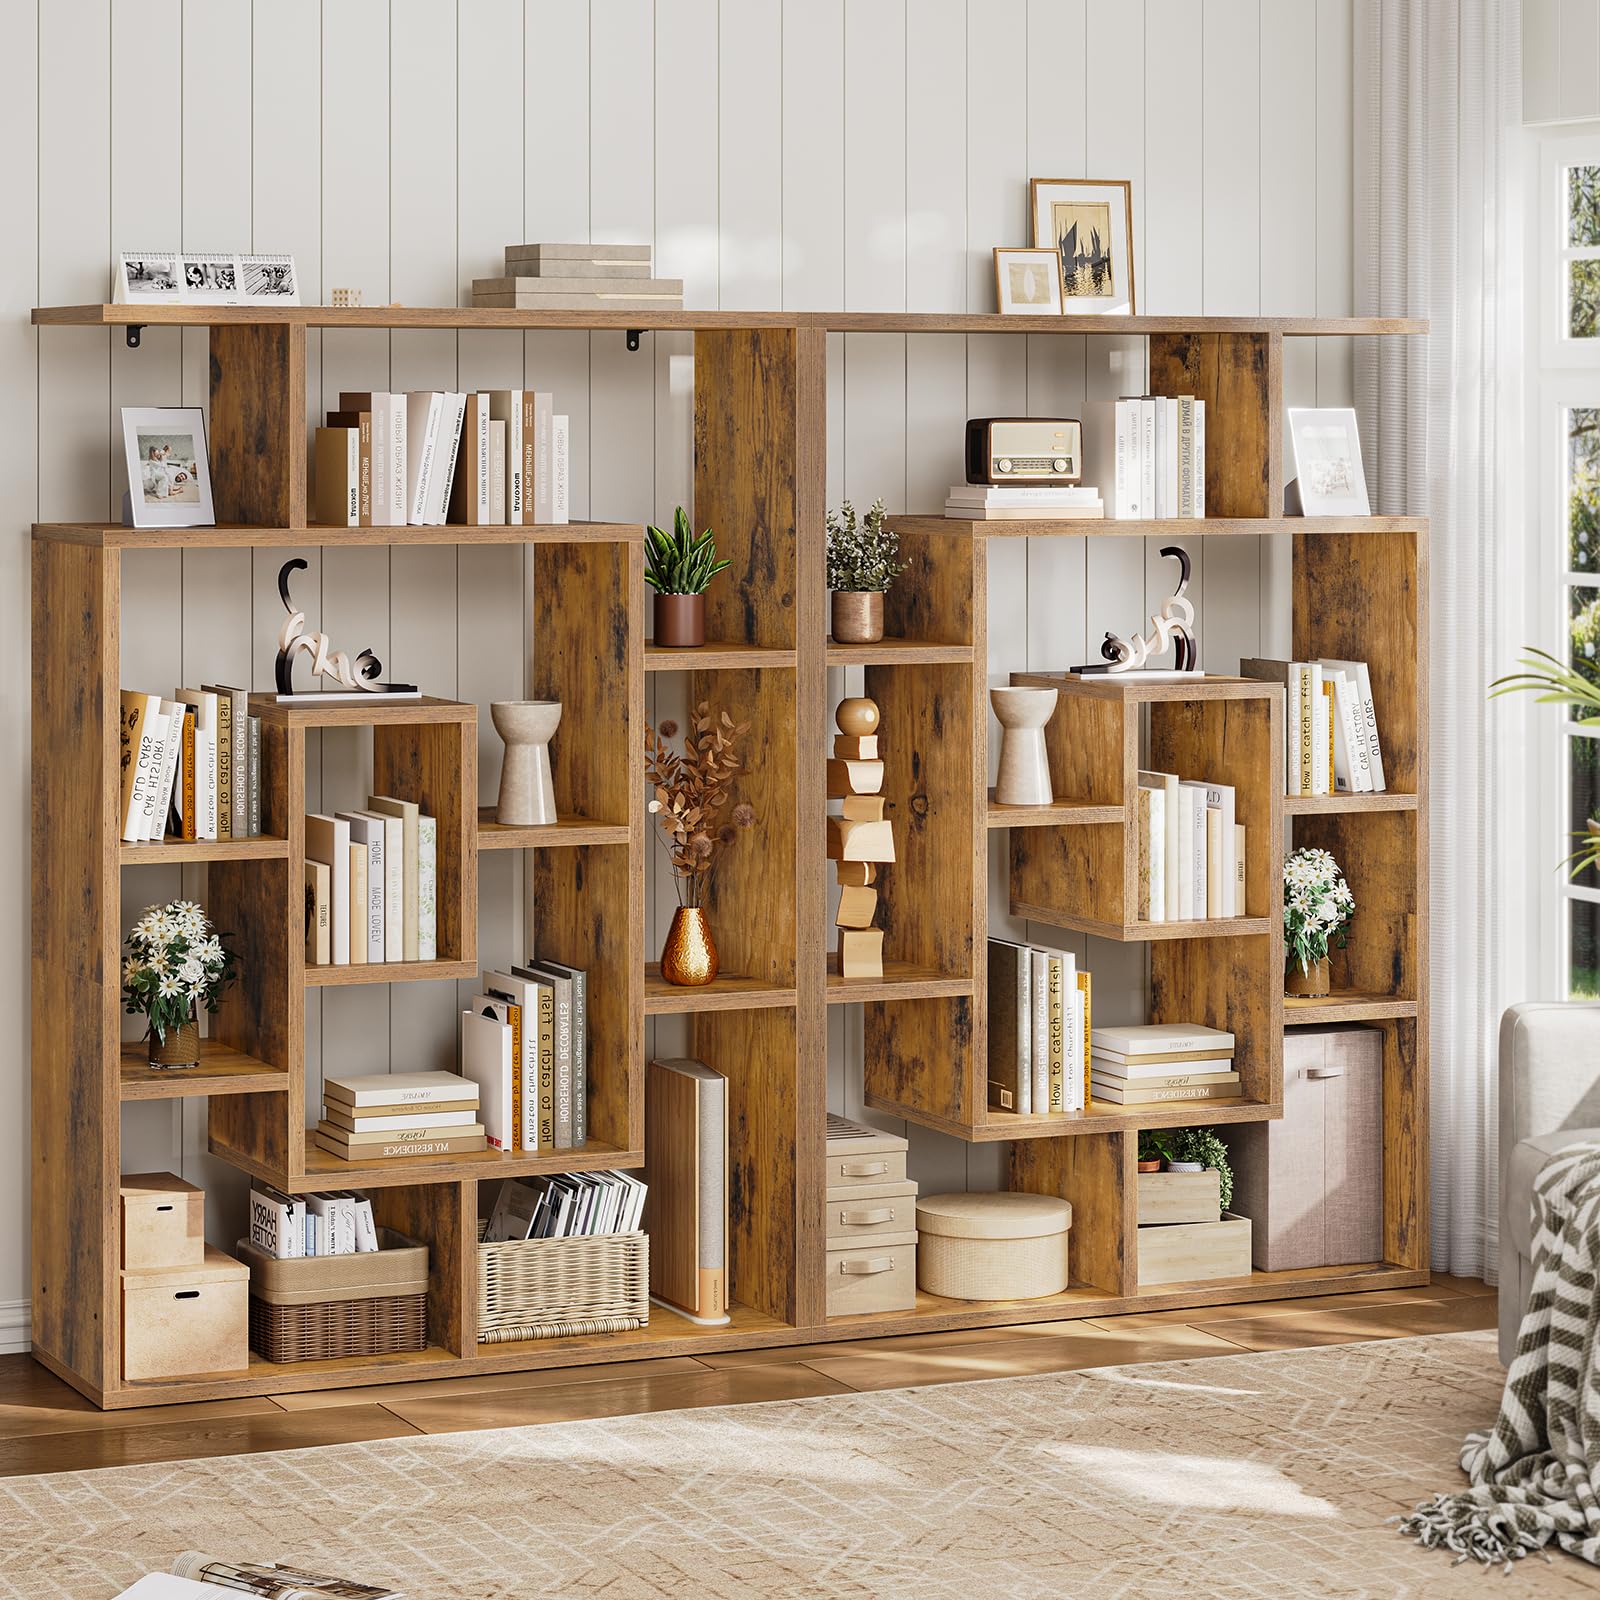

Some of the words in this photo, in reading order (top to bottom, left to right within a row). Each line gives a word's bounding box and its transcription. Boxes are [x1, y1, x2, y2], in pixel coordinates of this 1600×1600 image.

[1182, 400, 1192, 426] ДУМАЙ
[1181, 436, 1190, 465] ДРУГИХ
[1182, 468, 1190, 507] ФОРМАТАХ
[1302, 674, 1310, 698] fish
[1352, 702, 1365, 745] HISTORY
[1364, 699, 1375, 727] CARS
[1302, 717, 1310, 746] catch
[1370, 734, 1379, 756] OLD
[1303, 753, 1310, 764] to
[1358, 752, 1369, 770] CAR
[371, 841, 381, 865] HOME
[371, 887, 381, 910] MADE
[371, 915, 381, 943] LOVELY
[1050, 965, 1060, 994] fish
[1038, 975, 1046, 1028] DECORATES
[1051, 1017, 1061, 1053] catch
[1038, 1034, 1046, 1089] HOUSEHOLD
[1084, 1047, 1090, 1056] by
[1051, 1062, 1061, 1075] to
[1051, 1083, 1061, 1106] How
